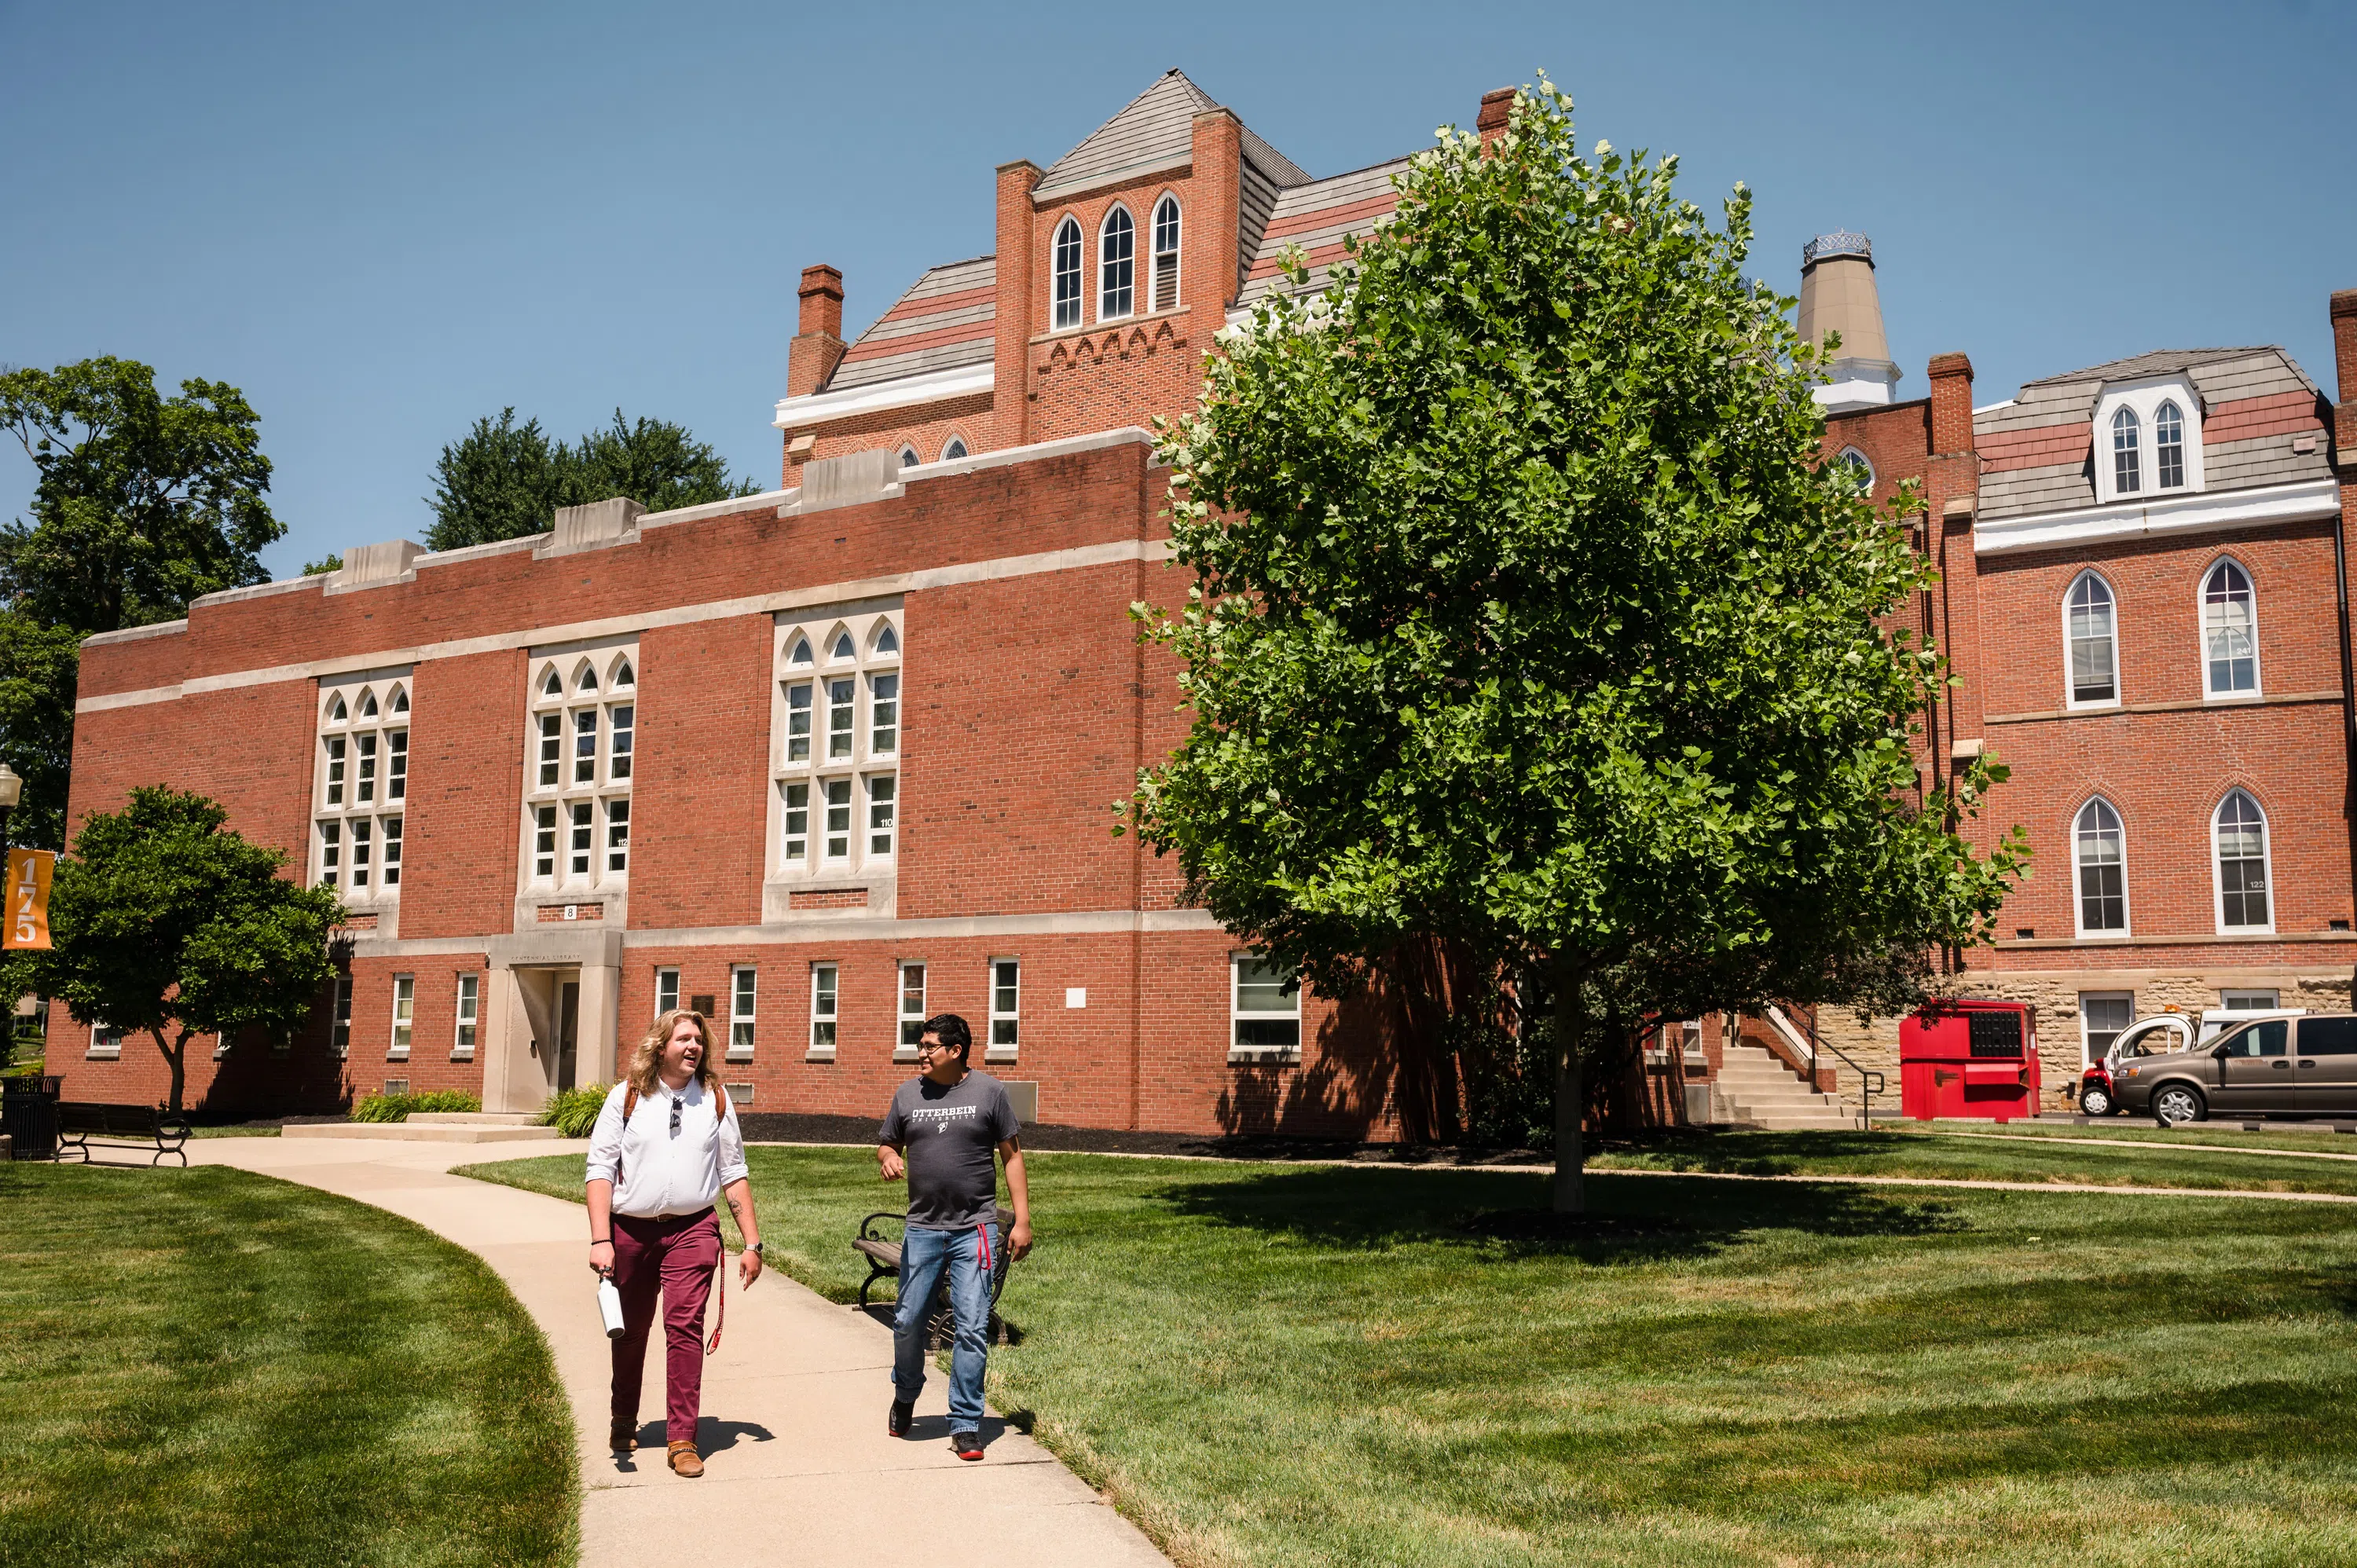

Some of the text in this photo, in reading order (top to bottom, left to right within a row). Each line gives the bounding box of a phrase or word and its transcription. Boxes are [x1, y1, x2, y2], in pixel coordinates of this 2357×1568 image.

[881, 818, 893, 827] 110
[618, 838, 628, 847] 112
[16, 857, 37, 943] 175
[568, 908, 574, 918] 8
[912, 1105, 977, 1118] OTTERBEIN
[912, 1114, 976, 1123] UNIVERSITY
